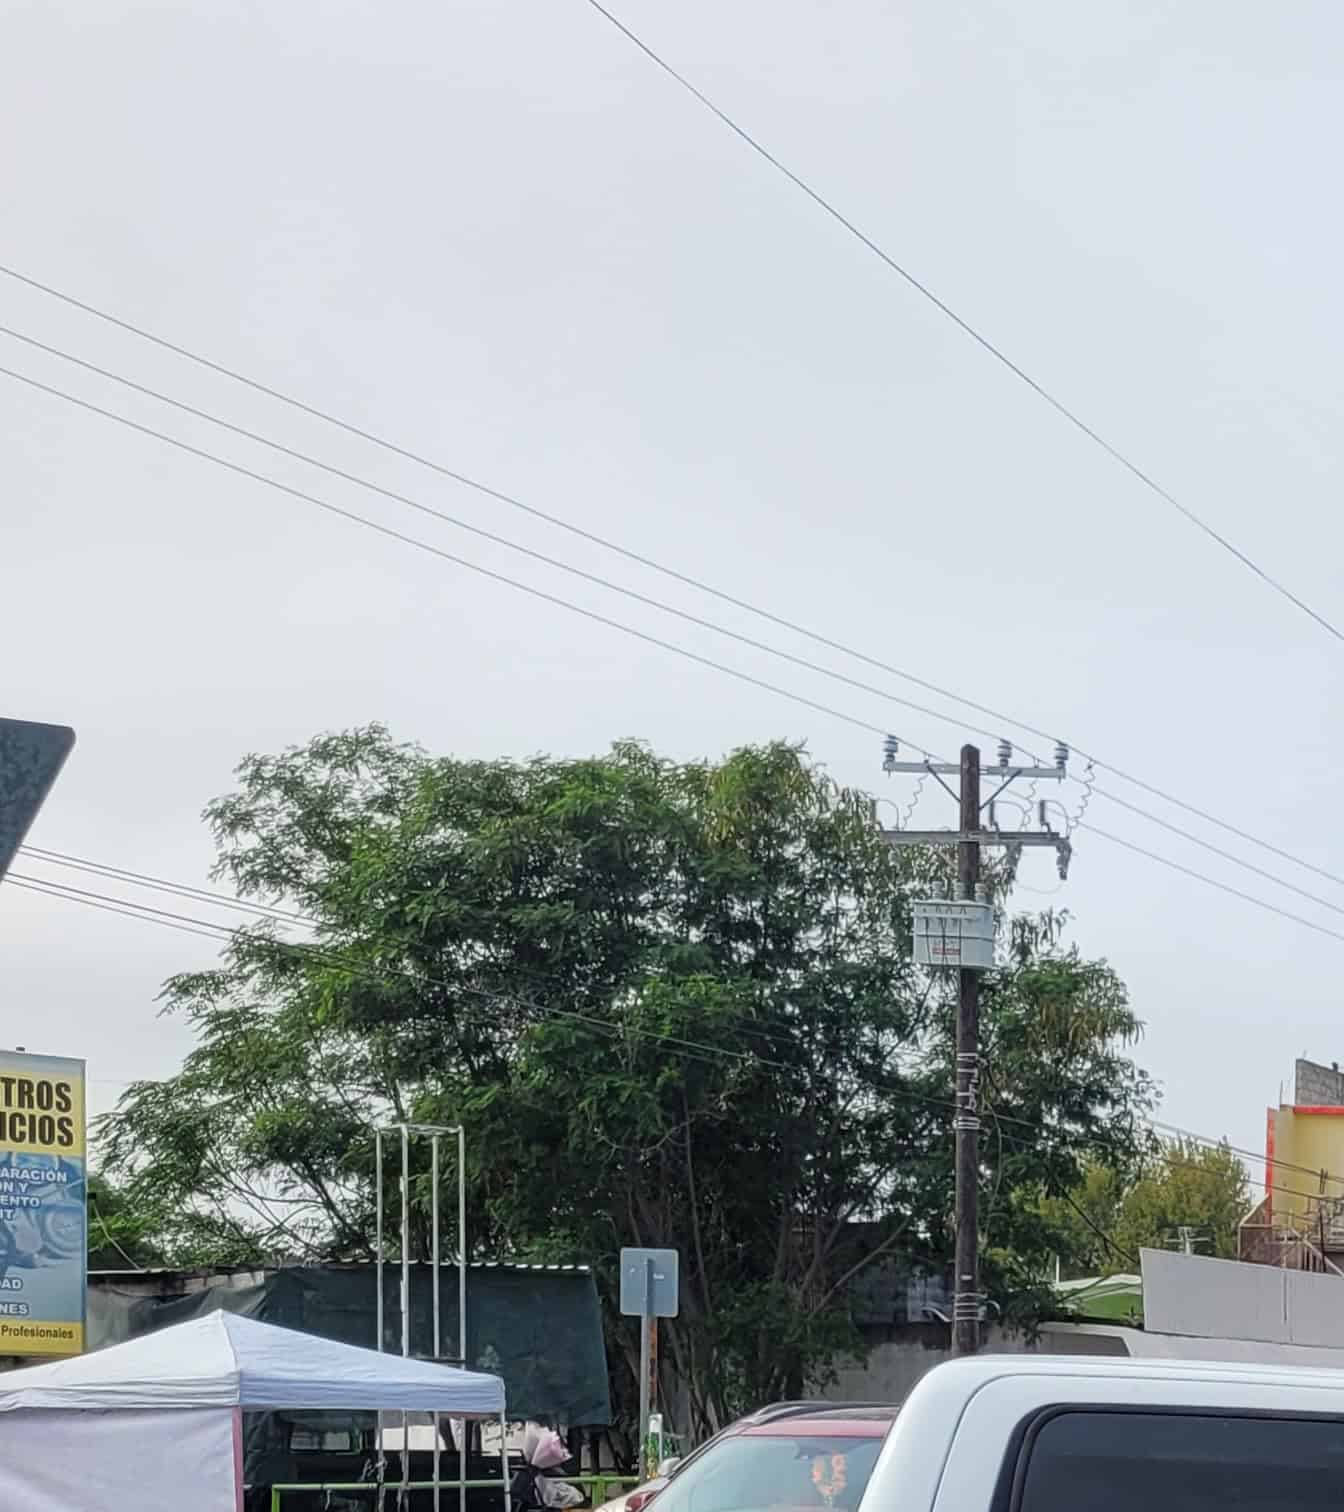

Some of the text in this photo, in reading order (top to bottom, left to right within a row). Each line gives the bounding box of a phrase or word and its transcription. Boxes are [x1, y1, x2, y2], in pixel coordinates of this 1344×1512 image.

[0, 1076, 73, 1113] TROS
[0, 1111, 74, 1147] ICIOS
[1, 1324, 74, 1339] Profesionales
